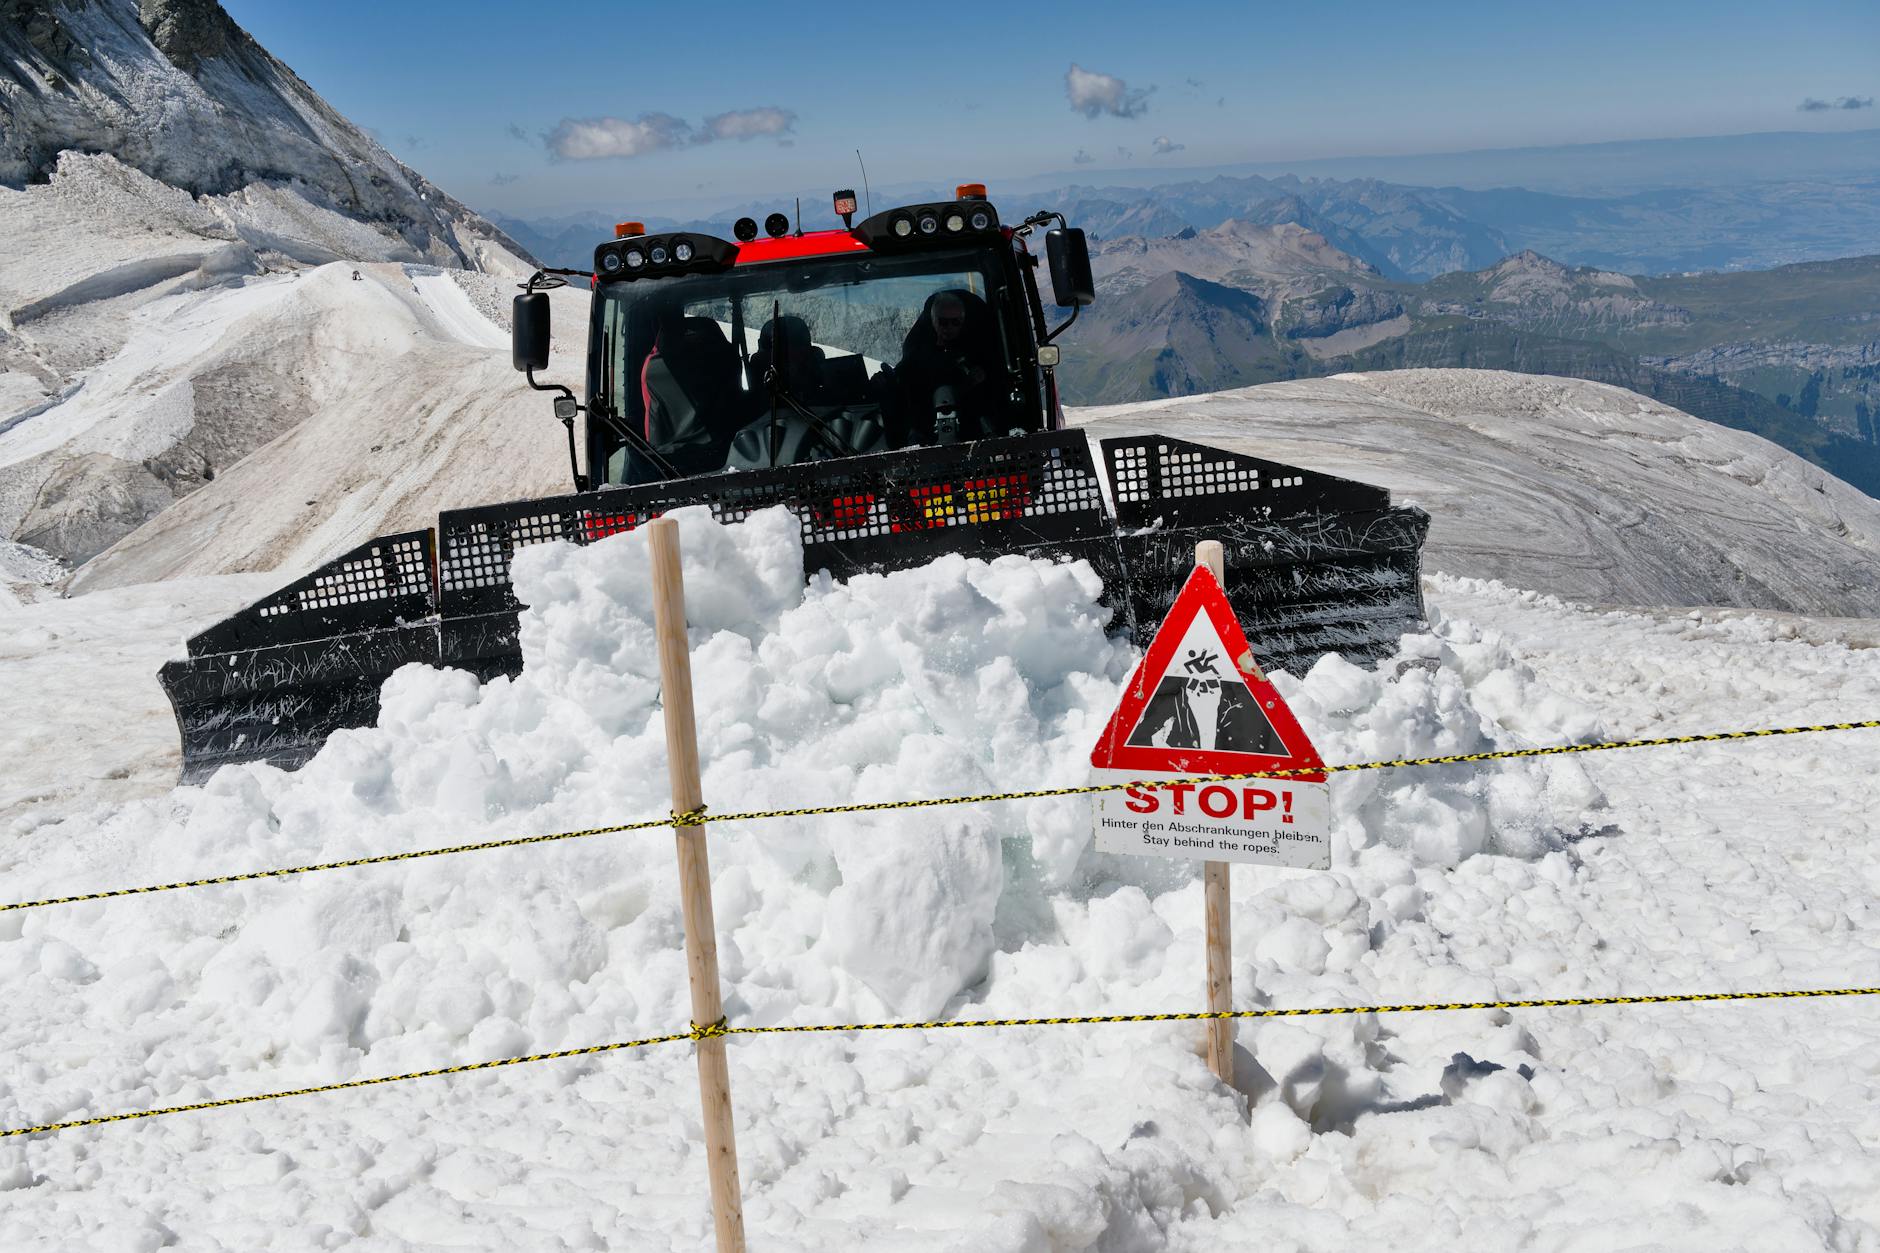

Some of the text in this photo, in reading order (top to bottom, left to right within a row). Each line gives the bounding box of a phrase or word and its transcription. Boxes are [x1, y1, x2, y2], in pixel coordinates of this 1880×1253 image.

[1125, 780, 1294, 824] STOP!
[1101, 817, 1323, 844] Hinter den Abschrankungen bleiben.
[1143, 834, 1280, 855] Stay behind the ropes.
